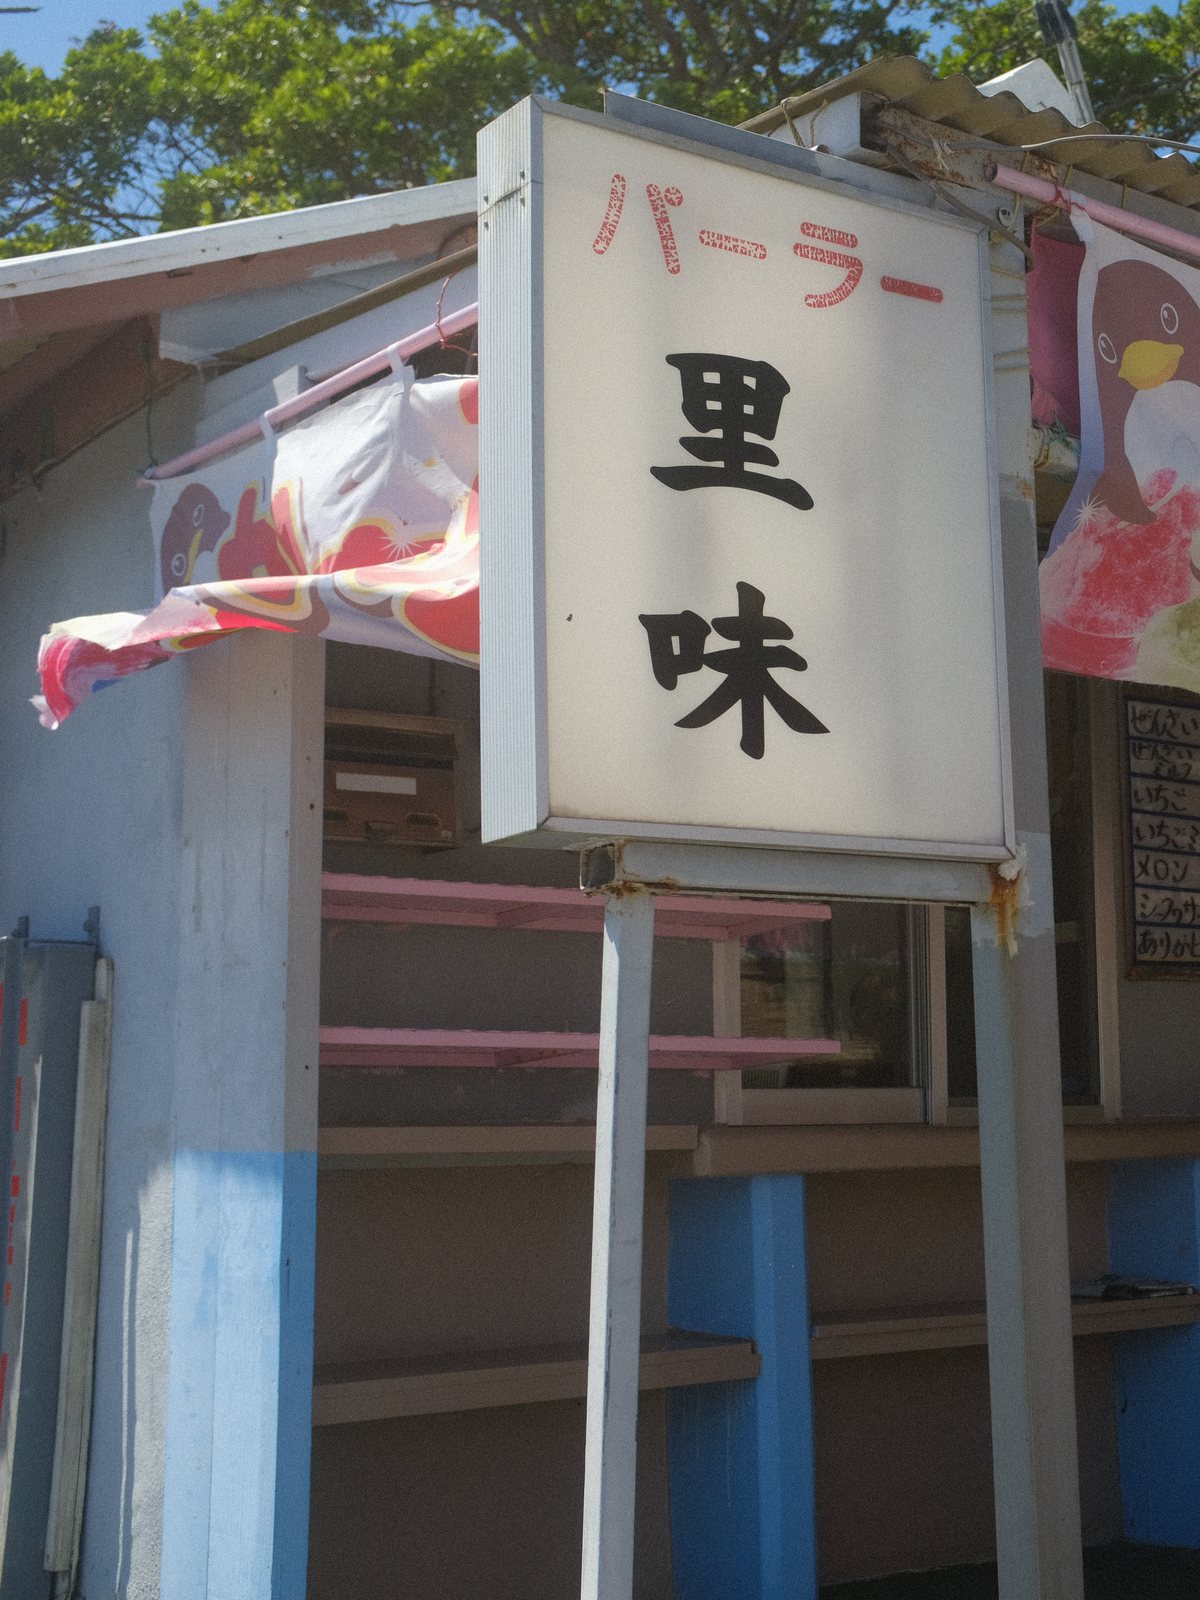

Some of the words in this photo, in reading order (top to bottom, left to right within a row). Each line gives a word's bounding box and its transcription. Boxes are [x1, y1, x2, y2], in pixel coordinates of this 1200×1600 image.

[592, 173, 943, 310] パーラー
[638, 352, 831, 761] 里味
[1131, 704, 1198, 740] ぜんざい
[1133, 784, 1187, 811] いちご
[1136, 854, 1188, 883] メロン
